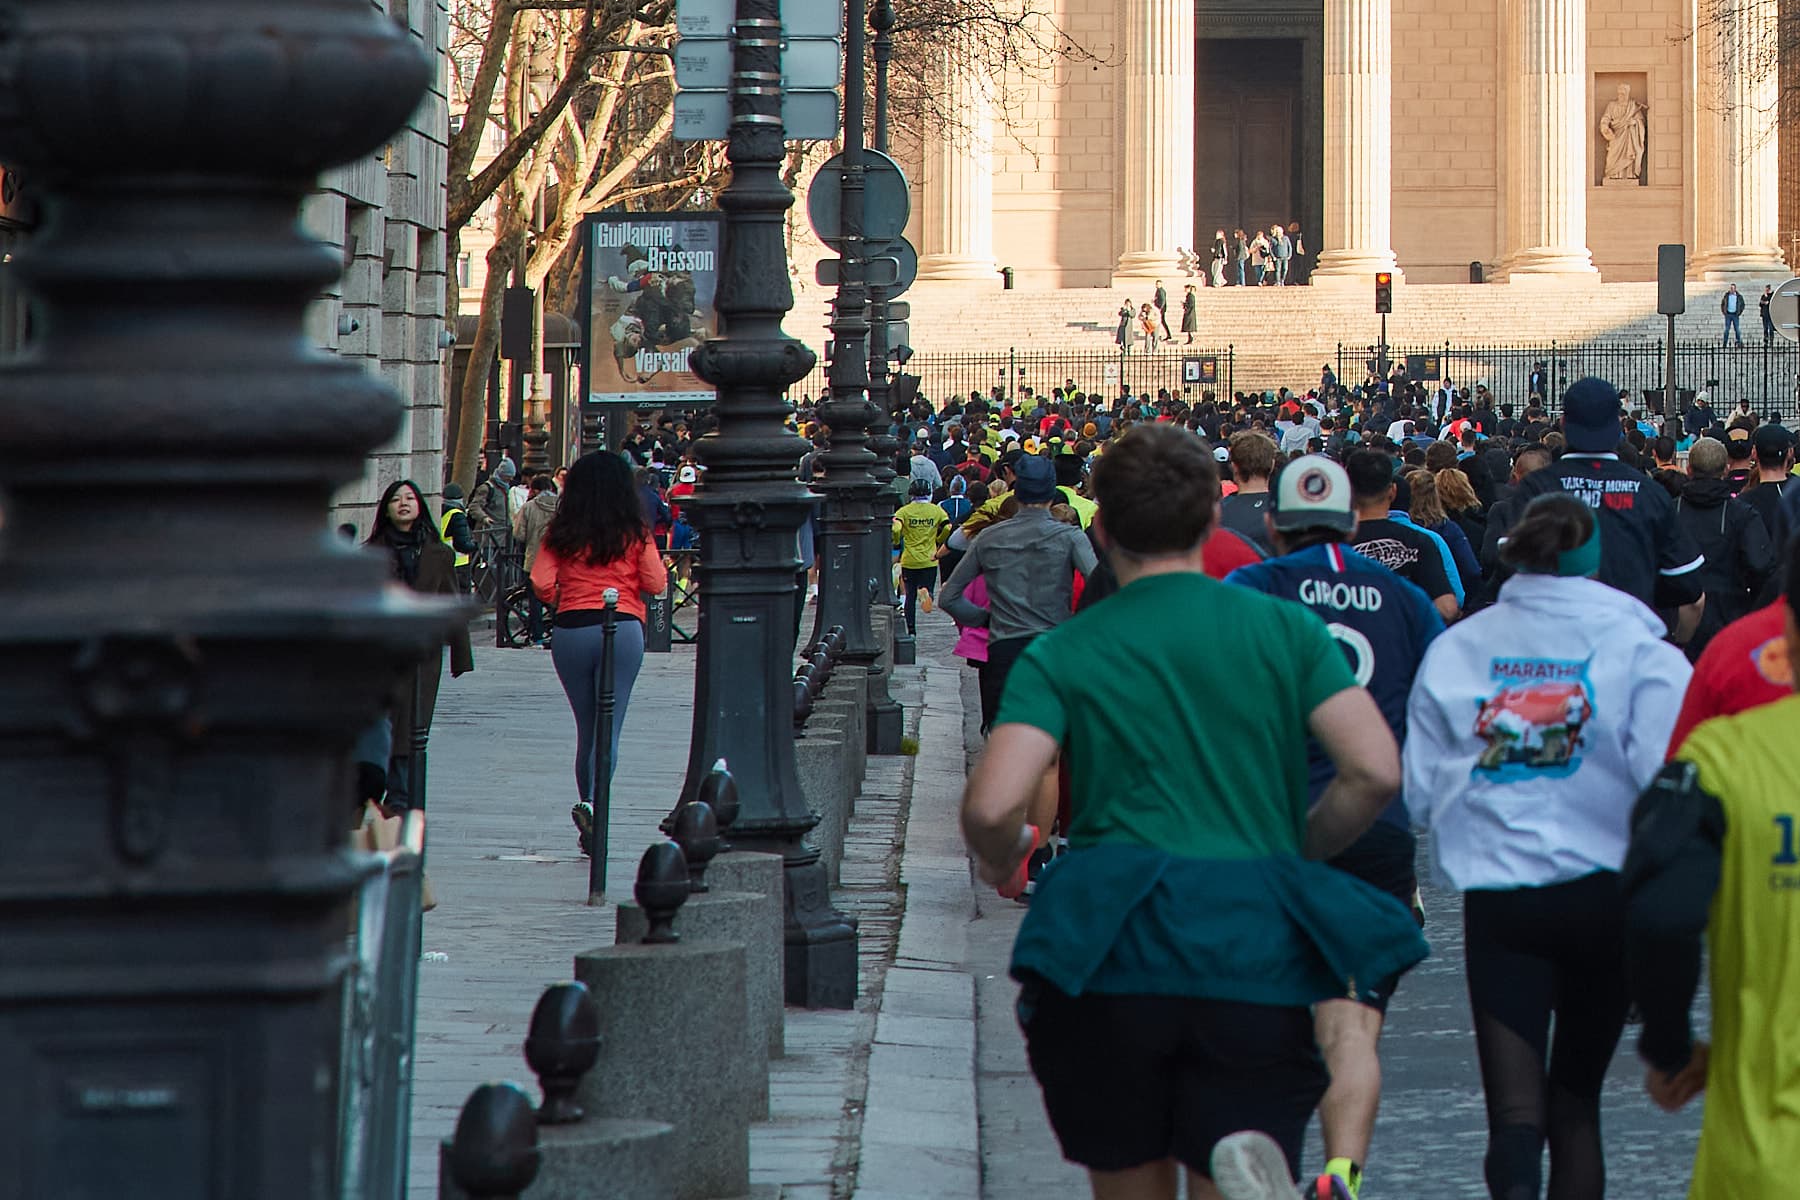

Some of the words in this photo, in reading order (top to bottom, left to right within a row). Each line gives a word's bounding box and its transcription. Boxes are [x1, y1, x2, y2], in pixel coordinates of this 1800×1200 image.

[598, 222, 673, 248] Guillaume
[648, 247, 714, 272] Bresson
[1560, 476, 1585, 490] TAKE
[1605, 480, 1640, 493] MONEY
[1298, 579, 1382, 612] GIROUD
